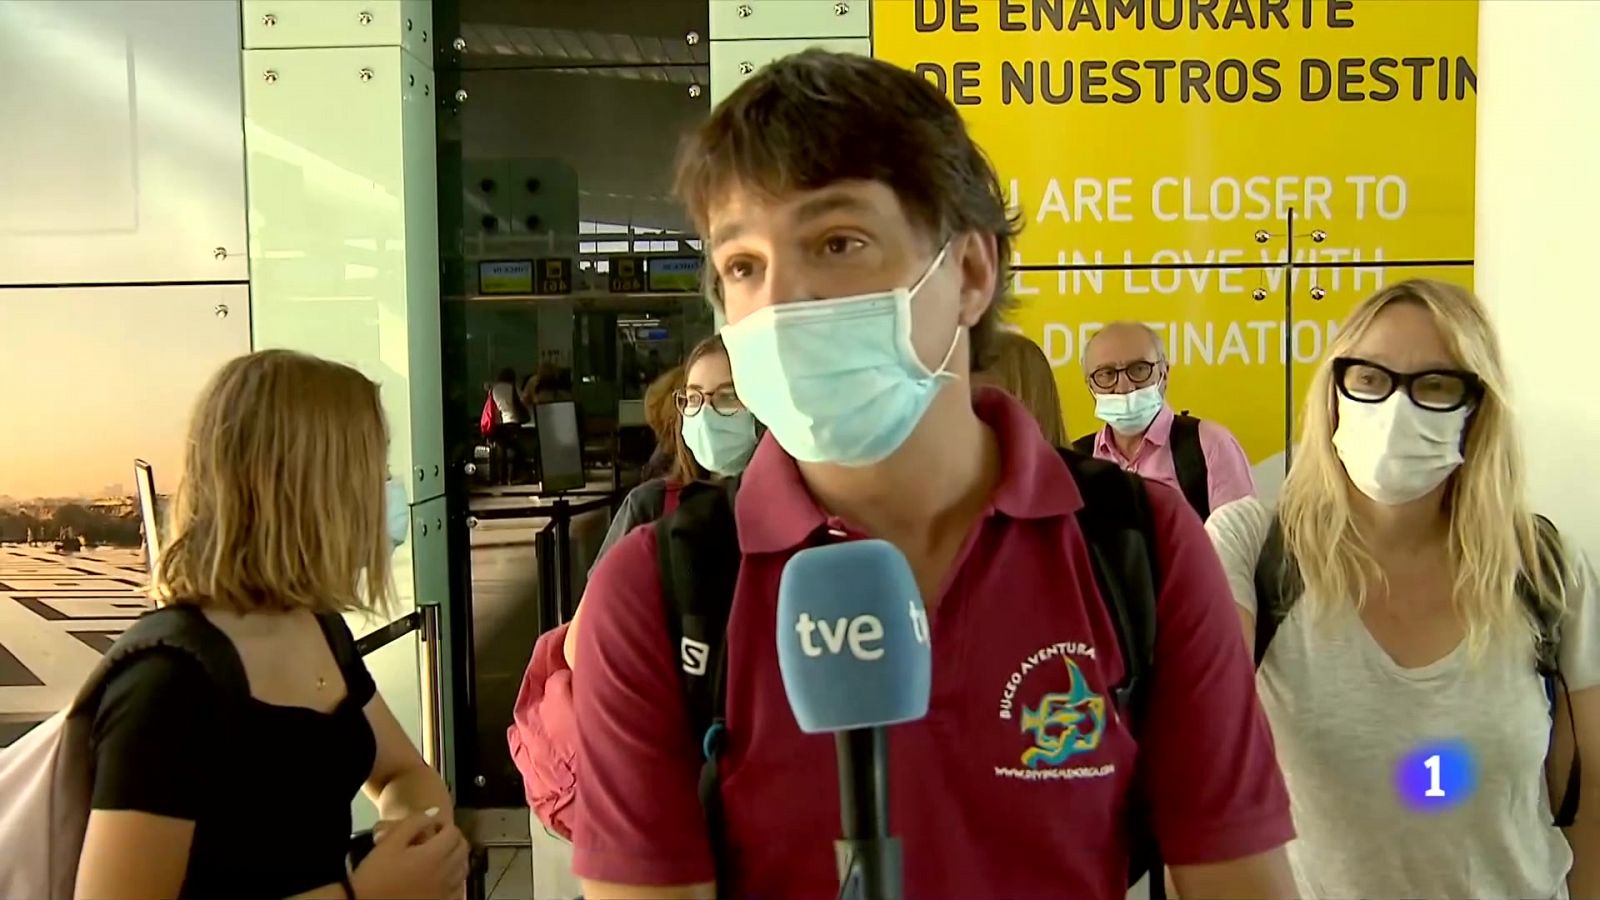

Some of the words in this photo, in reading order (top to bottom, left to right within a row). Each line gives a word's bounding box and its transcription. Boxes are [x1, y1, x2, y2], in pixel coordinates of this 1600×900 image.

[915, 0, 979, 32] DE
[915, 61, 982, 105] DE
[1001, 59, 1281, 105] NUESTROS
[1036, 176, 1133, 223] ARE
[1152, 175, 1333, 222] CLOSER
[1345, 175, 1407, 221] TO
[1057, 250, 1104, 295] IN
[1123, 249, 1245, 295] LOVE
[1260, 247, 1385, 294] WITH
[795, 612, 885, 661] tve
[999, 671, 1022, 720] BUCEO
[1020, 641, 1096, 676] AVENTURA
